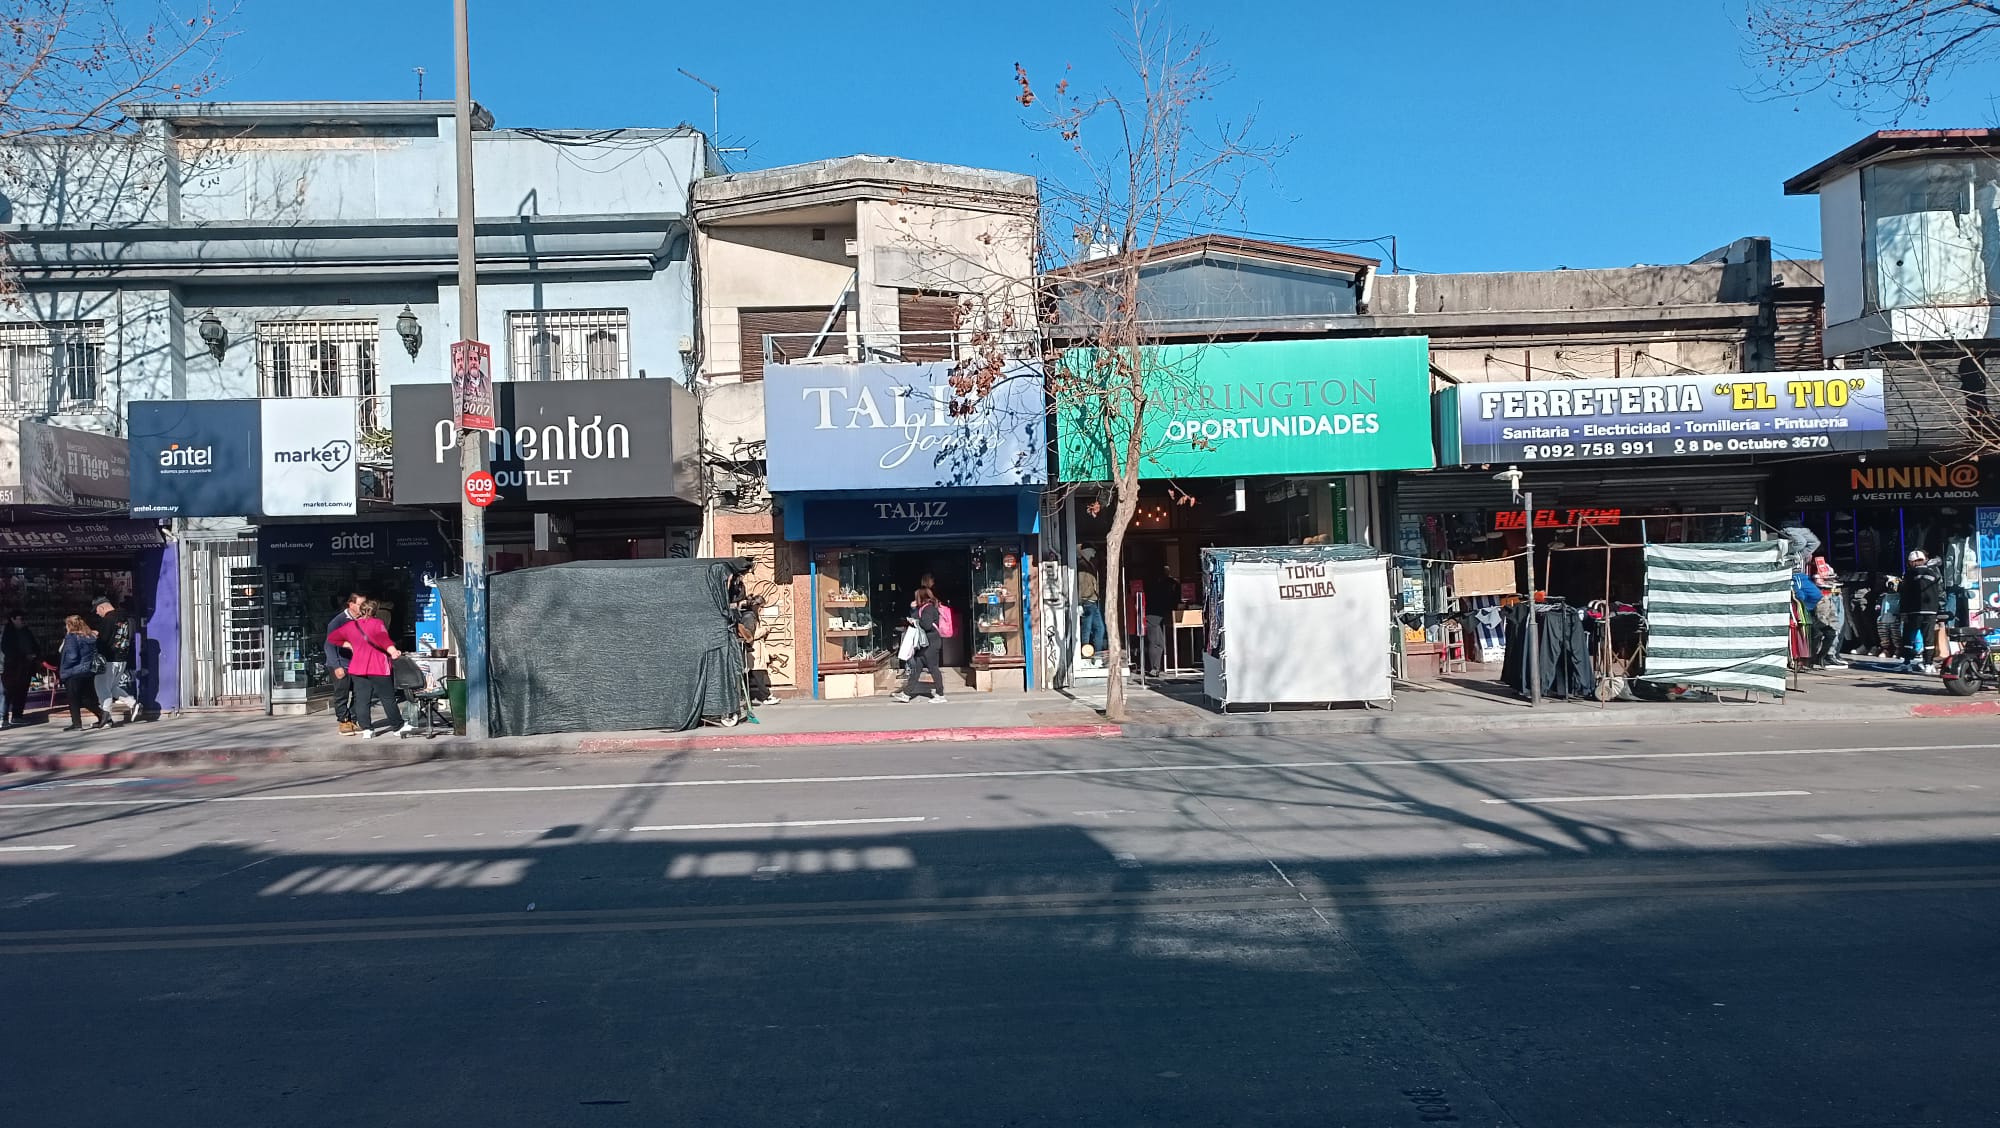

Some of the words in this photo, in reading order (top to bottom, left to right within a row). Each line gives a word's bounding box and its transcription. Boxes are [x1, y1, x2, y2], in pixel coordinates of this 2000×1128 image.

[463, 401, 490, 416] 9007
[1480, 384, 1704, 420] FERRETERIA
[1165, 413, 1380, 441] OPORTUNIDADES
[1502, 425, 1570, 440] Sanitaria
[1583, 422, 1671, 437] Electricidad
[160, 443, 212, 467] antel
[274, 446, 341, 463] market
[1539, 444, 1575, 459] 092
[1580, 442, 1615, 457] 758
[1621, 440, 1654, 456] 991
[1689, 440, 1699, 452] 8
[1703, 439, 1723, 451] De
[1727, 437, 1789, 450] Octubre
[1791, 435, 1829, 449] 3670
[80, 453, 110, 481] Tigre
[467, 478, 493, 492] 609
[494, 469, 573, 487] OUTLET
[1862, 492, 1911, 500] VESTITE
[1944, 490, 1980, 498] MODA
[133, 504, 180, 512] antel.com.uy
[873, 501, 948, 519] TALIZ
[908, 511, 944, 533] Joyas
[0, 531, 69, 547] Tigre
[331, 532, 375, 549] antel
[1279, 580, 1337, 599] COSTURA
